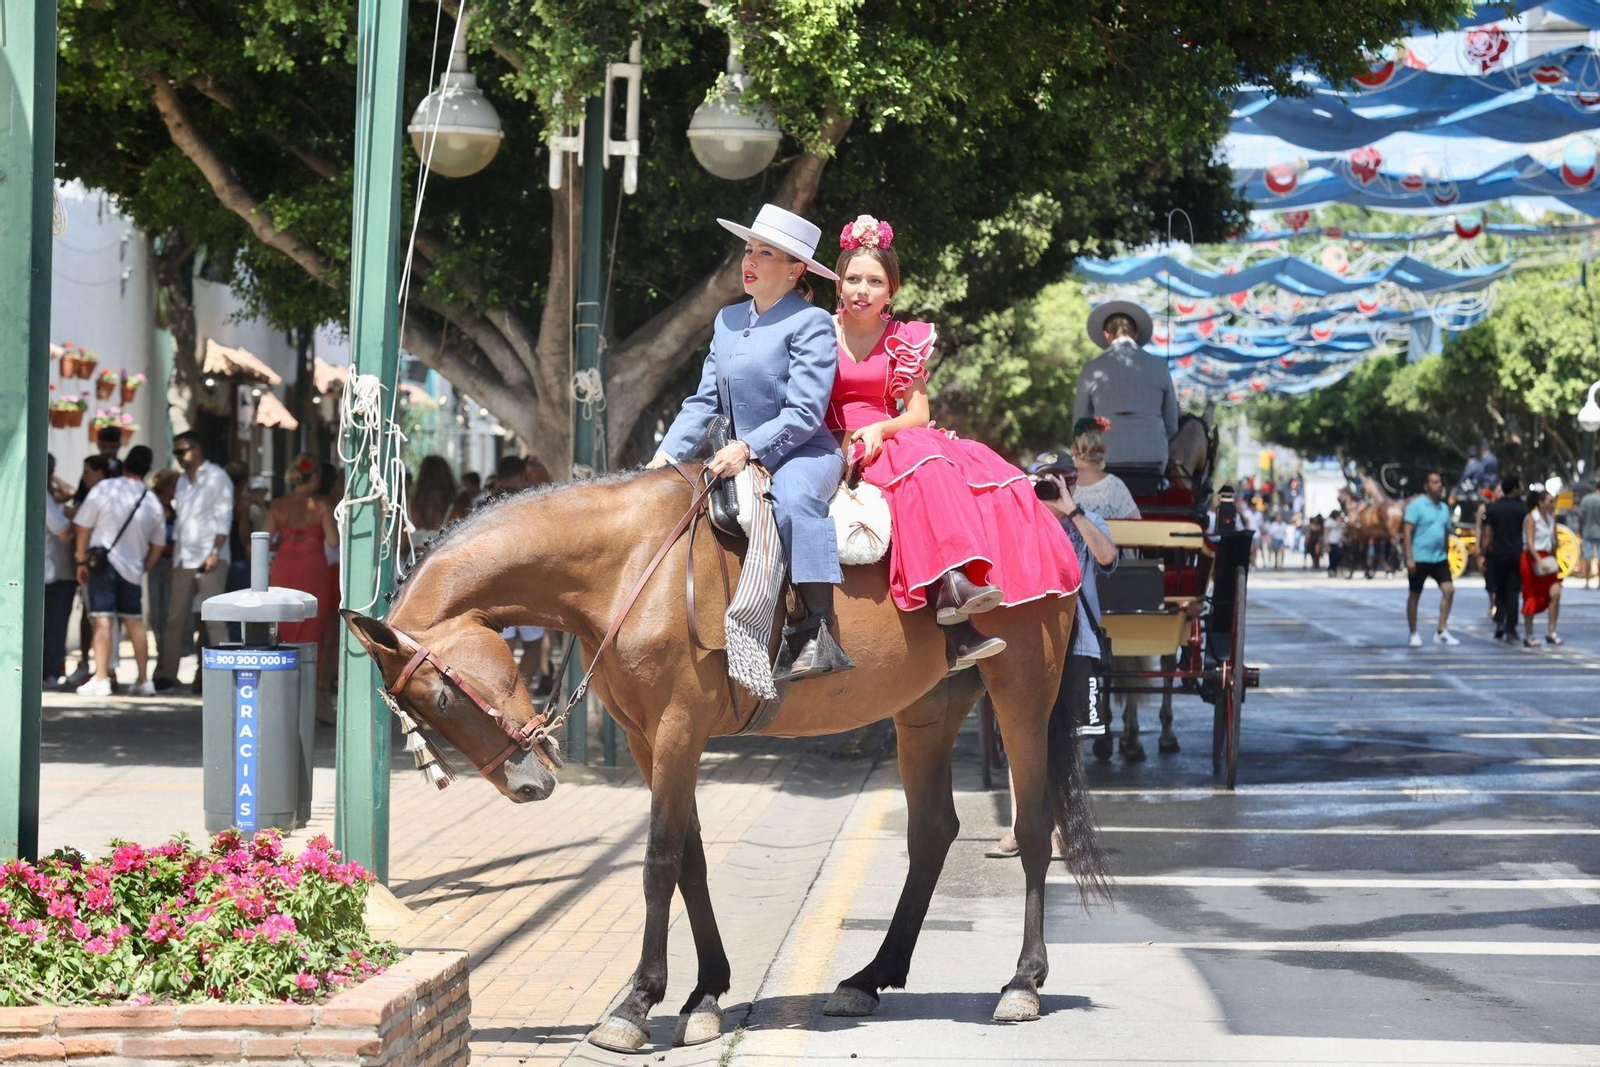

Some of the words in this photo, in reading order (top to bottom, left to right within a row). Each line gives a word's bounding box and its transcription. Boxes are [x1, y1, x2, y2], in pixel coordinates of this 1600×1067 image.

[216, 655, 235, 665] 900
[236, 655, 258, 665] 900
[260, 656, 280, 665] 000
[239, 685, 253, 816] GRACIAS
